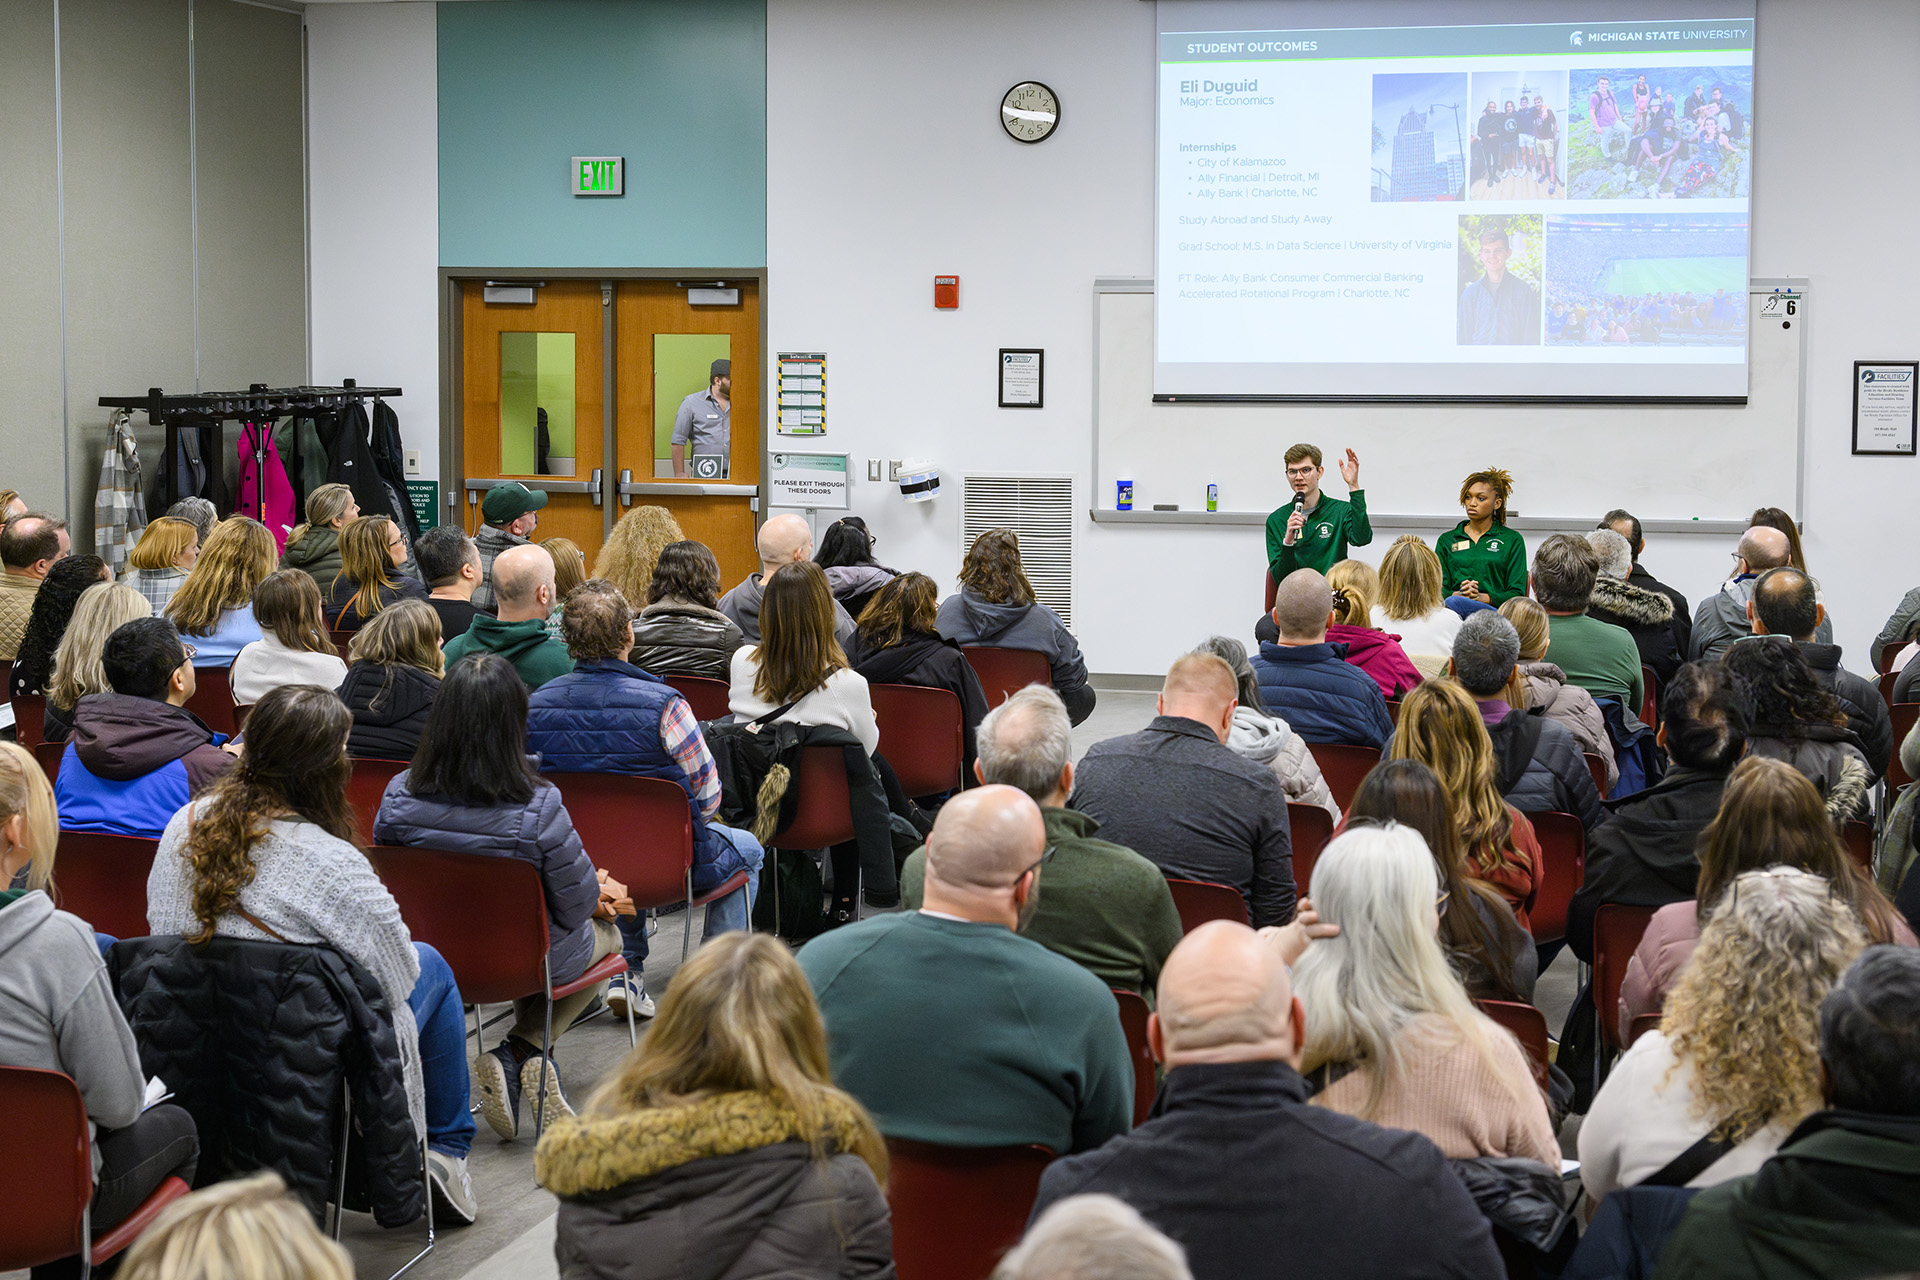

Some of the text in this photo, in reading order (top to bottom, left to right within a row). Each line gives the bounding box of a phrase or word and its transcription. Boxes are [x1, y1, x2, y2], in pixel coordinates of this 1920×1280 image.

[1588, 29, 1748, 42] MICHIGAN STATE UNIVERSITY
[1187, 41, 1318, 54] STUDENT OUTCOMES
[1180, 79, 1258, 95] Eli Duguid
[1026, 90, 1035, 98] 12
[1180, 95, 1275, 109] Major: Economics
[1179, 142, 1237, 153] Internships
[1197, 157, 1287, 169] City of Kalamazoo
[580, 161, 616, 191] EXIT
[1197, 173, 1216, 184] Ally
[1218, 172, 1261, 183] Financial
[1268, 172, 1306, 183] Detroit,
[1308, 172, 1320, 182] MI
[1197, 188, 1216, 200] Ally
[1218, 188, 1243, 198] Bank
[1251, 187, 1299, 198] Charlotte,
[1302, 187, 1318, 197] NC
[1178, 214, 1333, 227] Study Abroad and Study Away
[1178, 241, 1203, 251] Grad
[1205, 241, 1240, 251] School:
[1242, 241, 1264, 251] M.S.
[1266, 240, 1275, 250] in
[1277, 240, 1300, 250] Data
[1303, 240, 1341, 250] Science
[1349, 240, 1399, 251] University
[1401, 239, 1412, 249] of
[1415, 239, 1452, 251] Virginia
[1178, 272, 1424, 284] FT Role: Ally Bank Consumer Commercial Banking
[1178, 289, 1238, 299] Accelerated
[1240, 288, 1290, 298] Rotational
[1292, 288, 1335, 299] Program
[1343, 288, 1392, 299] Charlotte,
[1394, 288, 1410, 298] NC
[1786, 300, 1796, 316] 6
